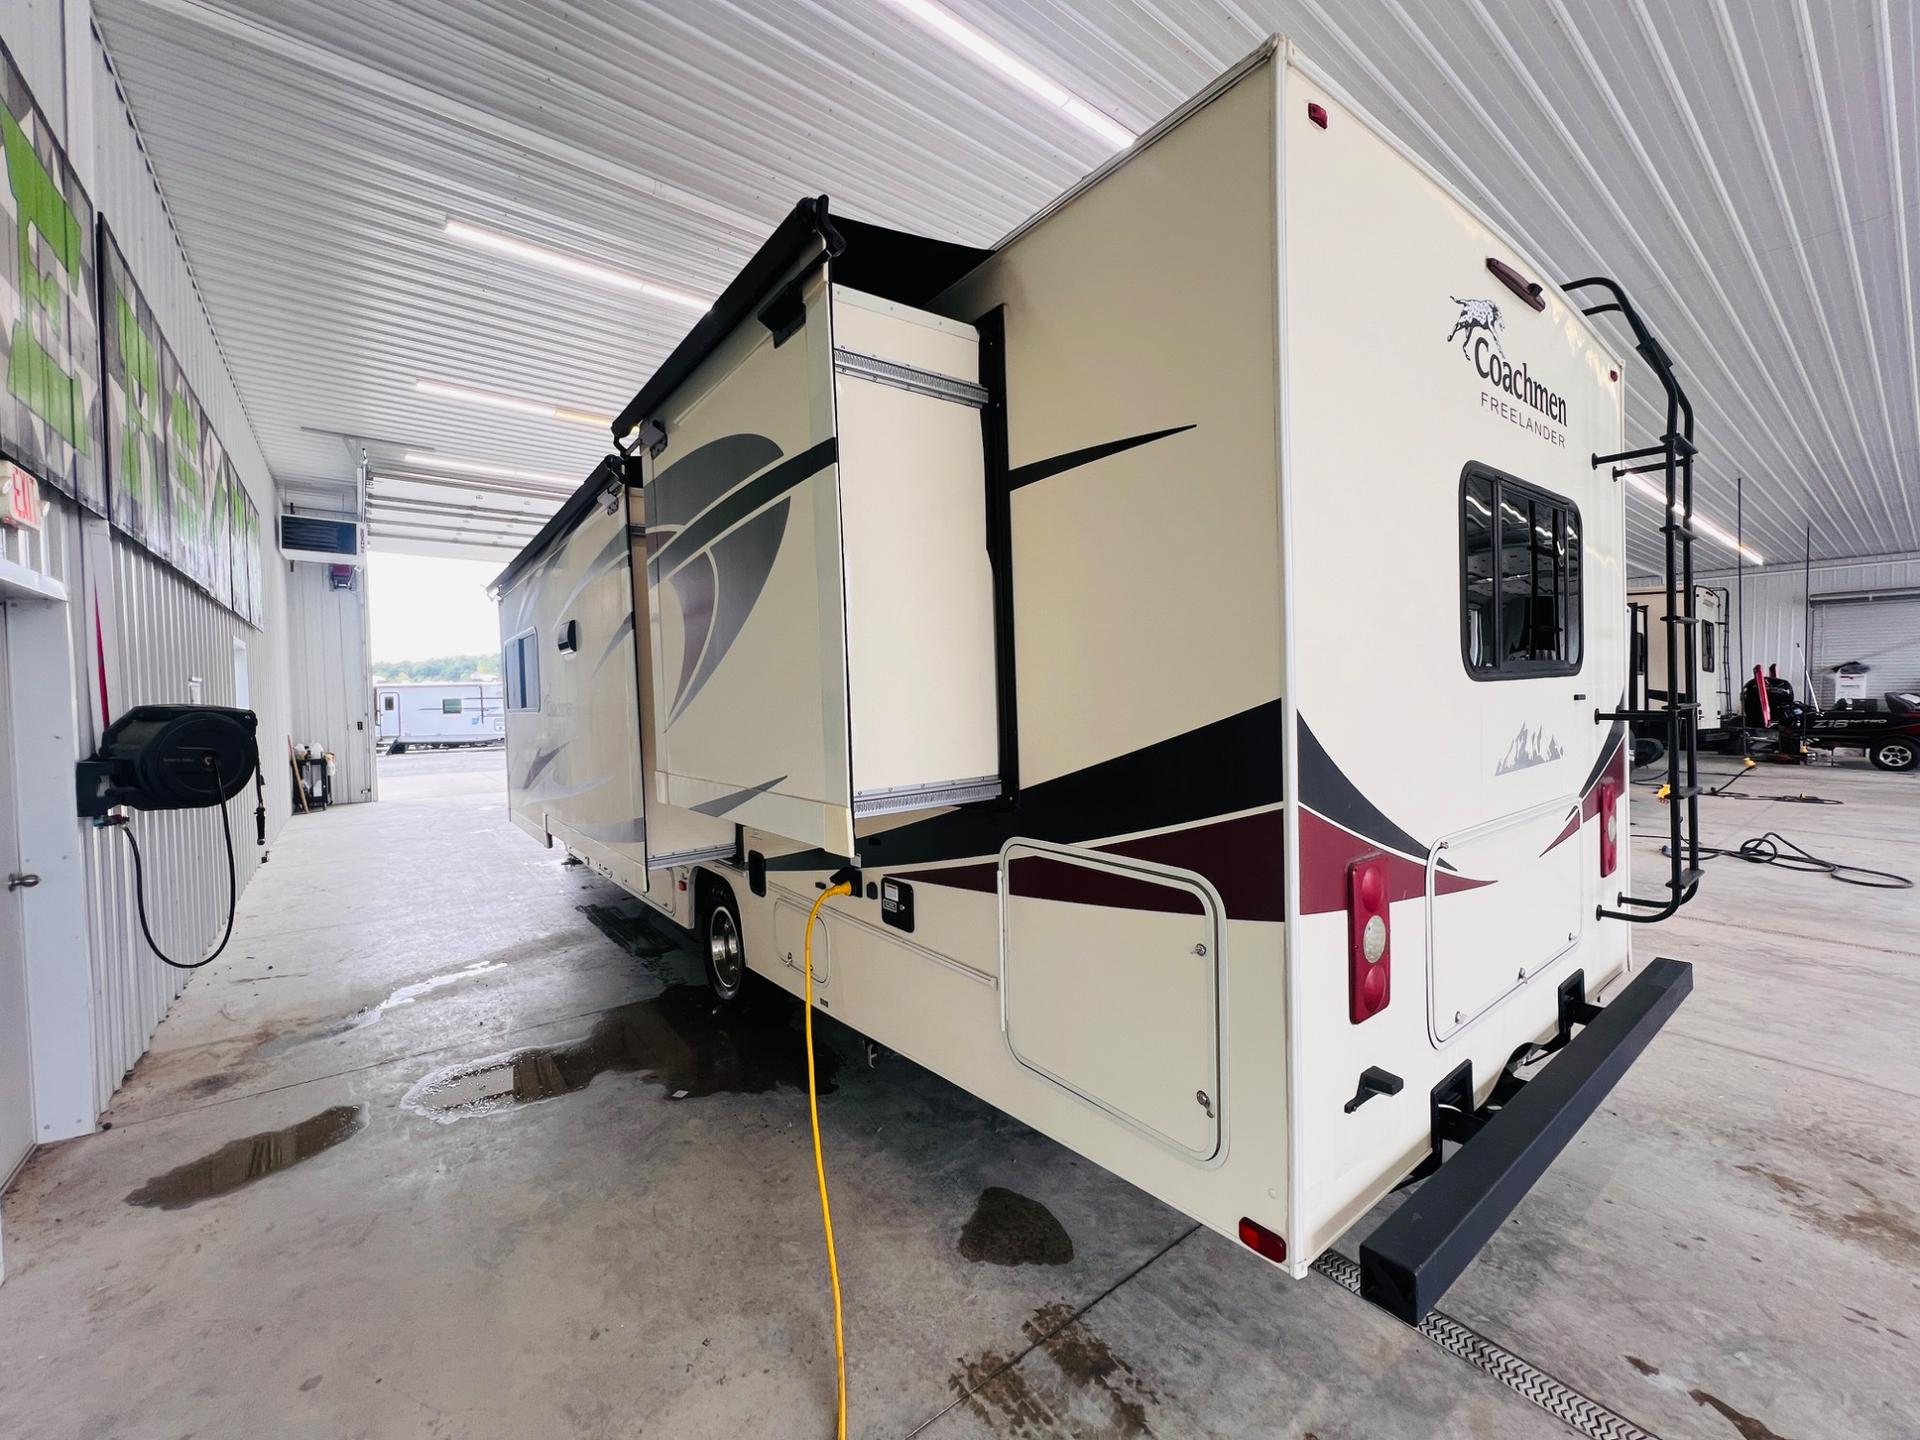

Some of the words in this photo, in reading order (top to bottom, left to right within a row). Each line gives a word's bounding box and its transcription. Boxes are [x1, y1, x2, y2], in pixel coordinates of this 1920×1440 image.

[1475, 337, 1567, 427] Coachmen
[1481, 392, 1565, 448] FREELANDER
[12, 466, 40, 525] EXIT
[1813, 720, 1849, 729] Z18
